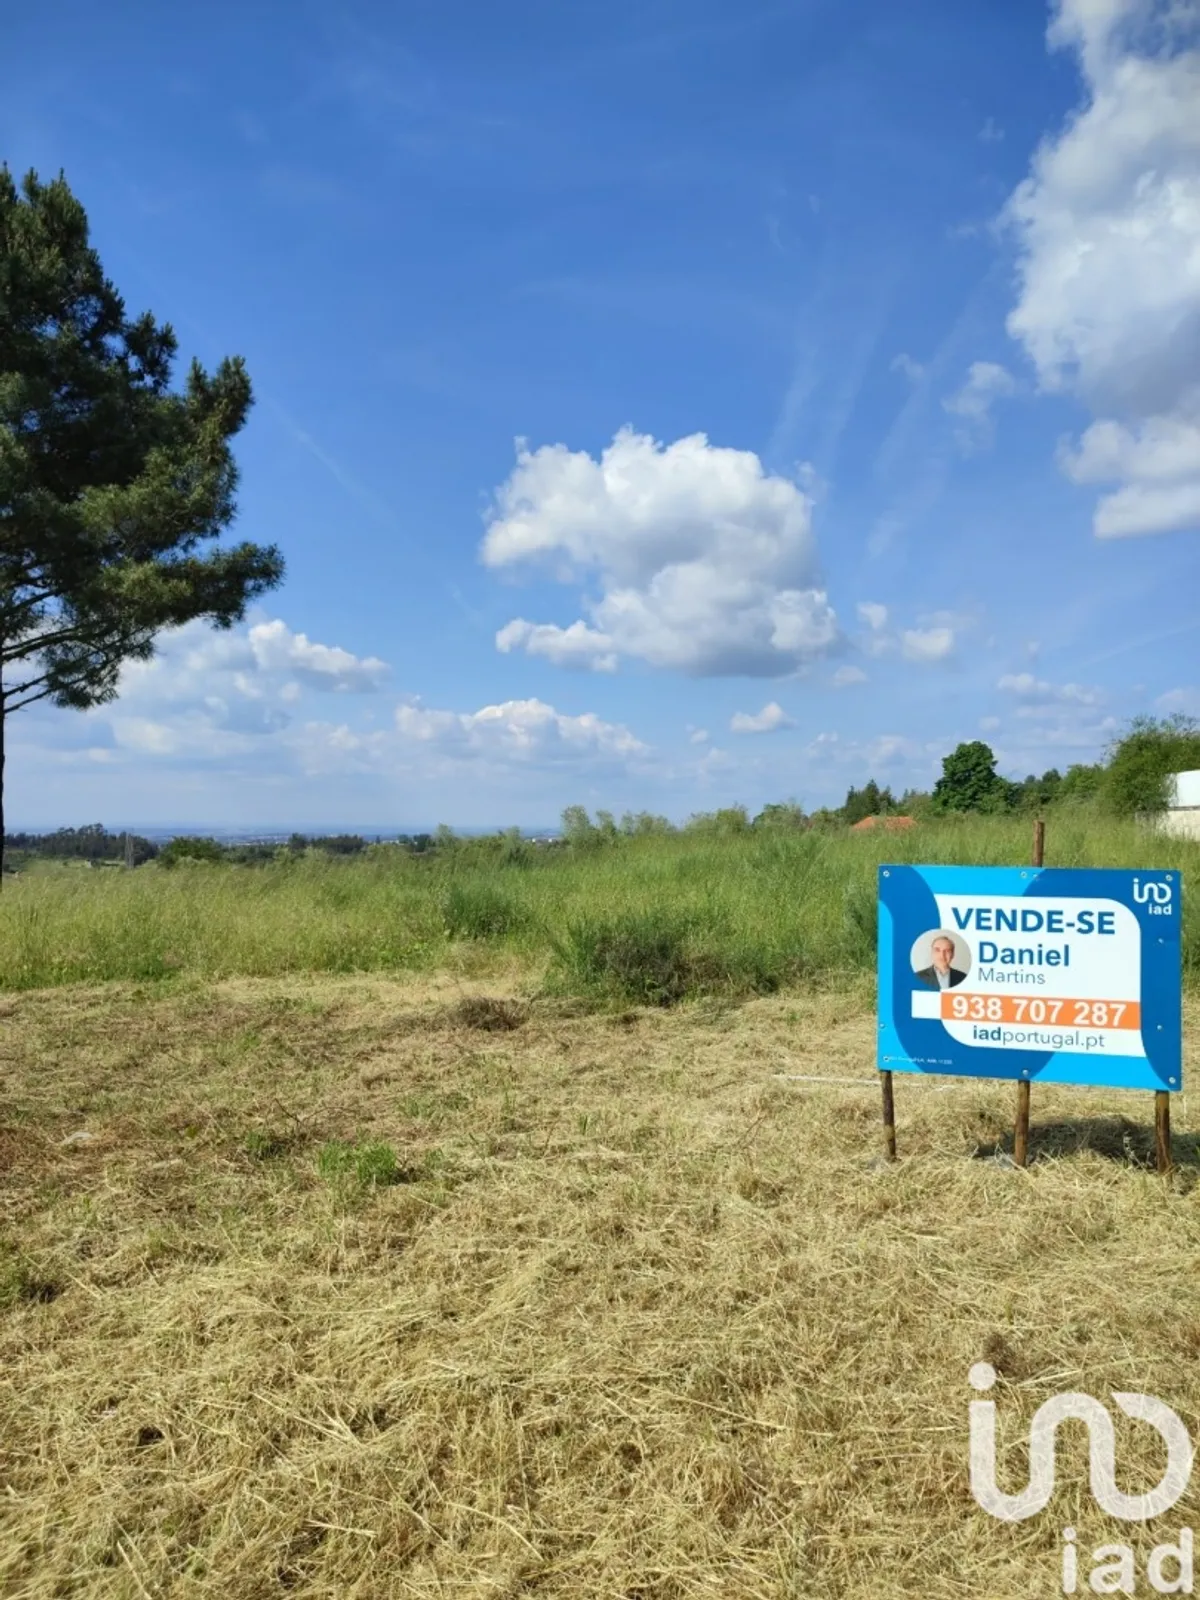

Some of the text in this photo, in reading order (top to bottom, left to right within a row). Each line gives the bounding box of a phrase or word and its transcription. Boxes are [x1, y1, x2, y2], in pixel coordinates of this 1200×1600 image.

[952, 907, 1116, 935] VENDE-SE
[1148, 903, 1172, 915] iad
[978, 941, 1070, 967] Daniel
[978, 967, 1046, 985] Martins
[952, 995, 1127, 1027] 938 707 287
[973, 1025, 1105, 1050] iadportugal.pt
